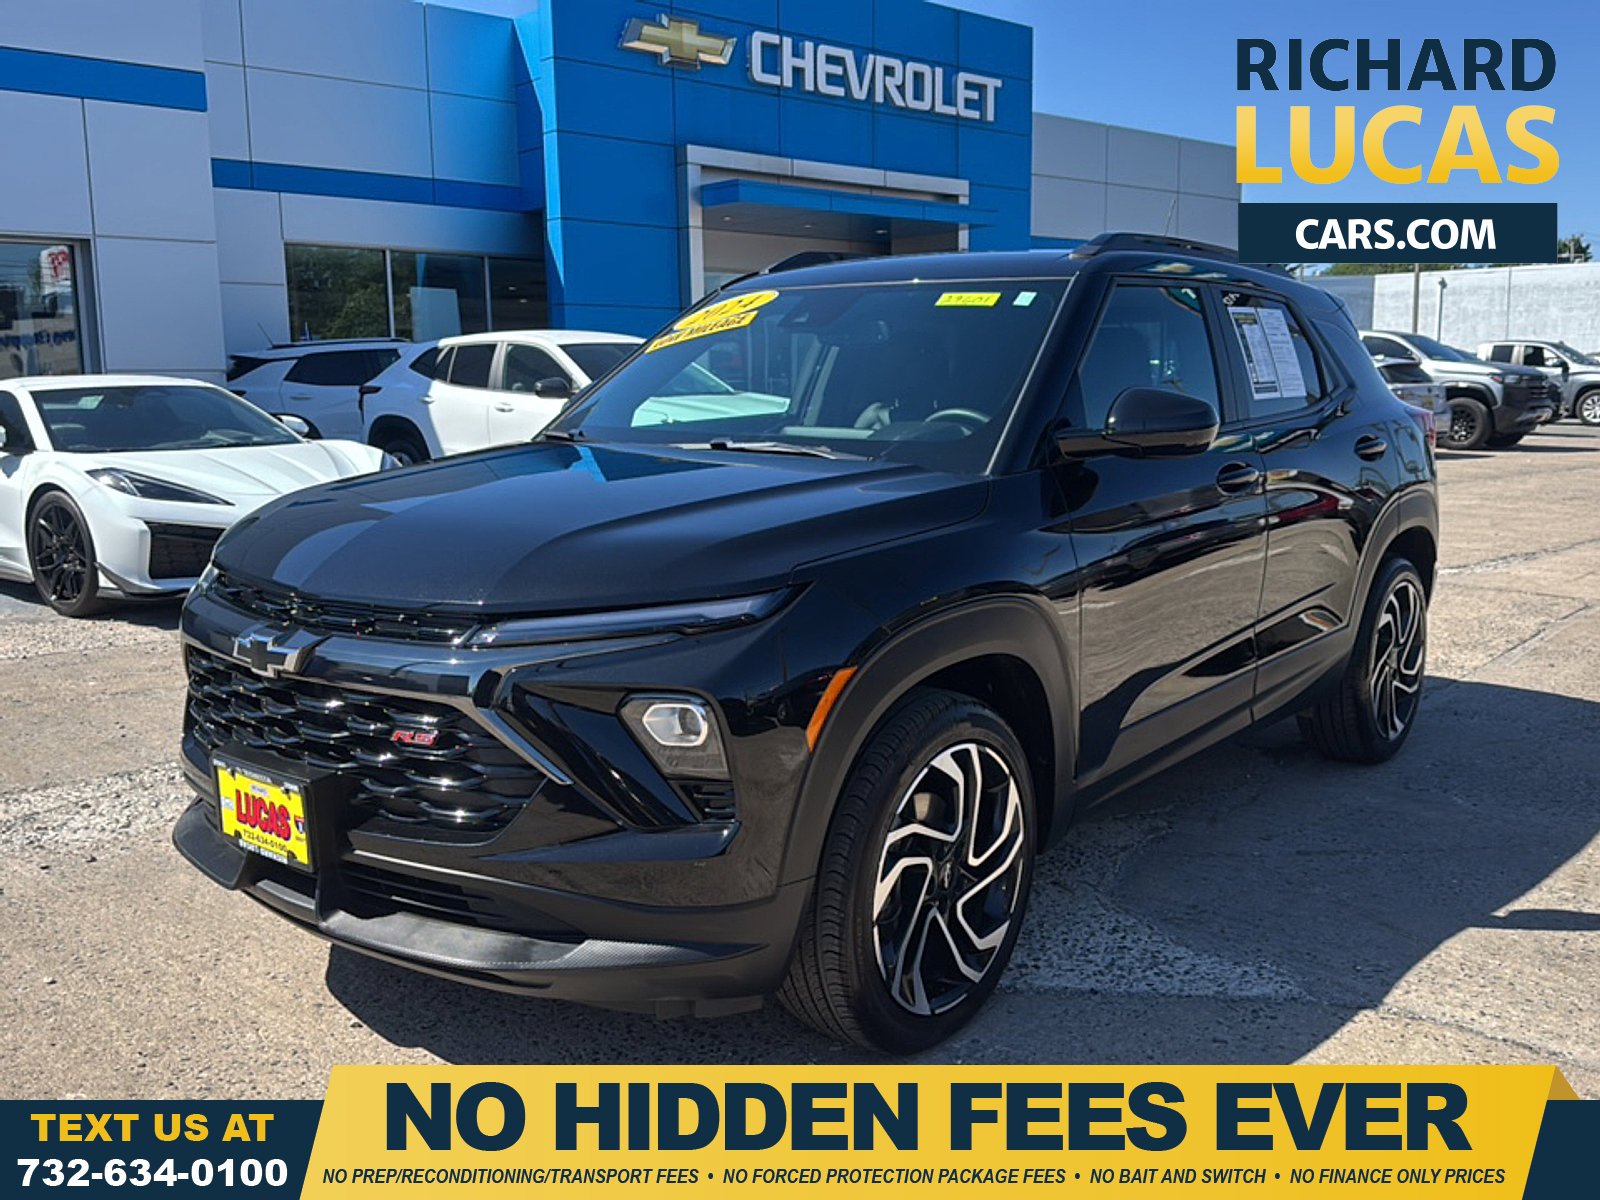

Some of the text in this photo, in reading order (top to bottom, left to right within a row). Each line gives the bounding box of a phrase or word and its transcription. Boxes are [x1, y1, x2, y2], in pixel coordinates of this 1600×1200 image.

[748, 30, 1003, 123] CHEVROLET
[390, 729, 439, 746] RS
[235, 788, 292, 842] LUCAS
